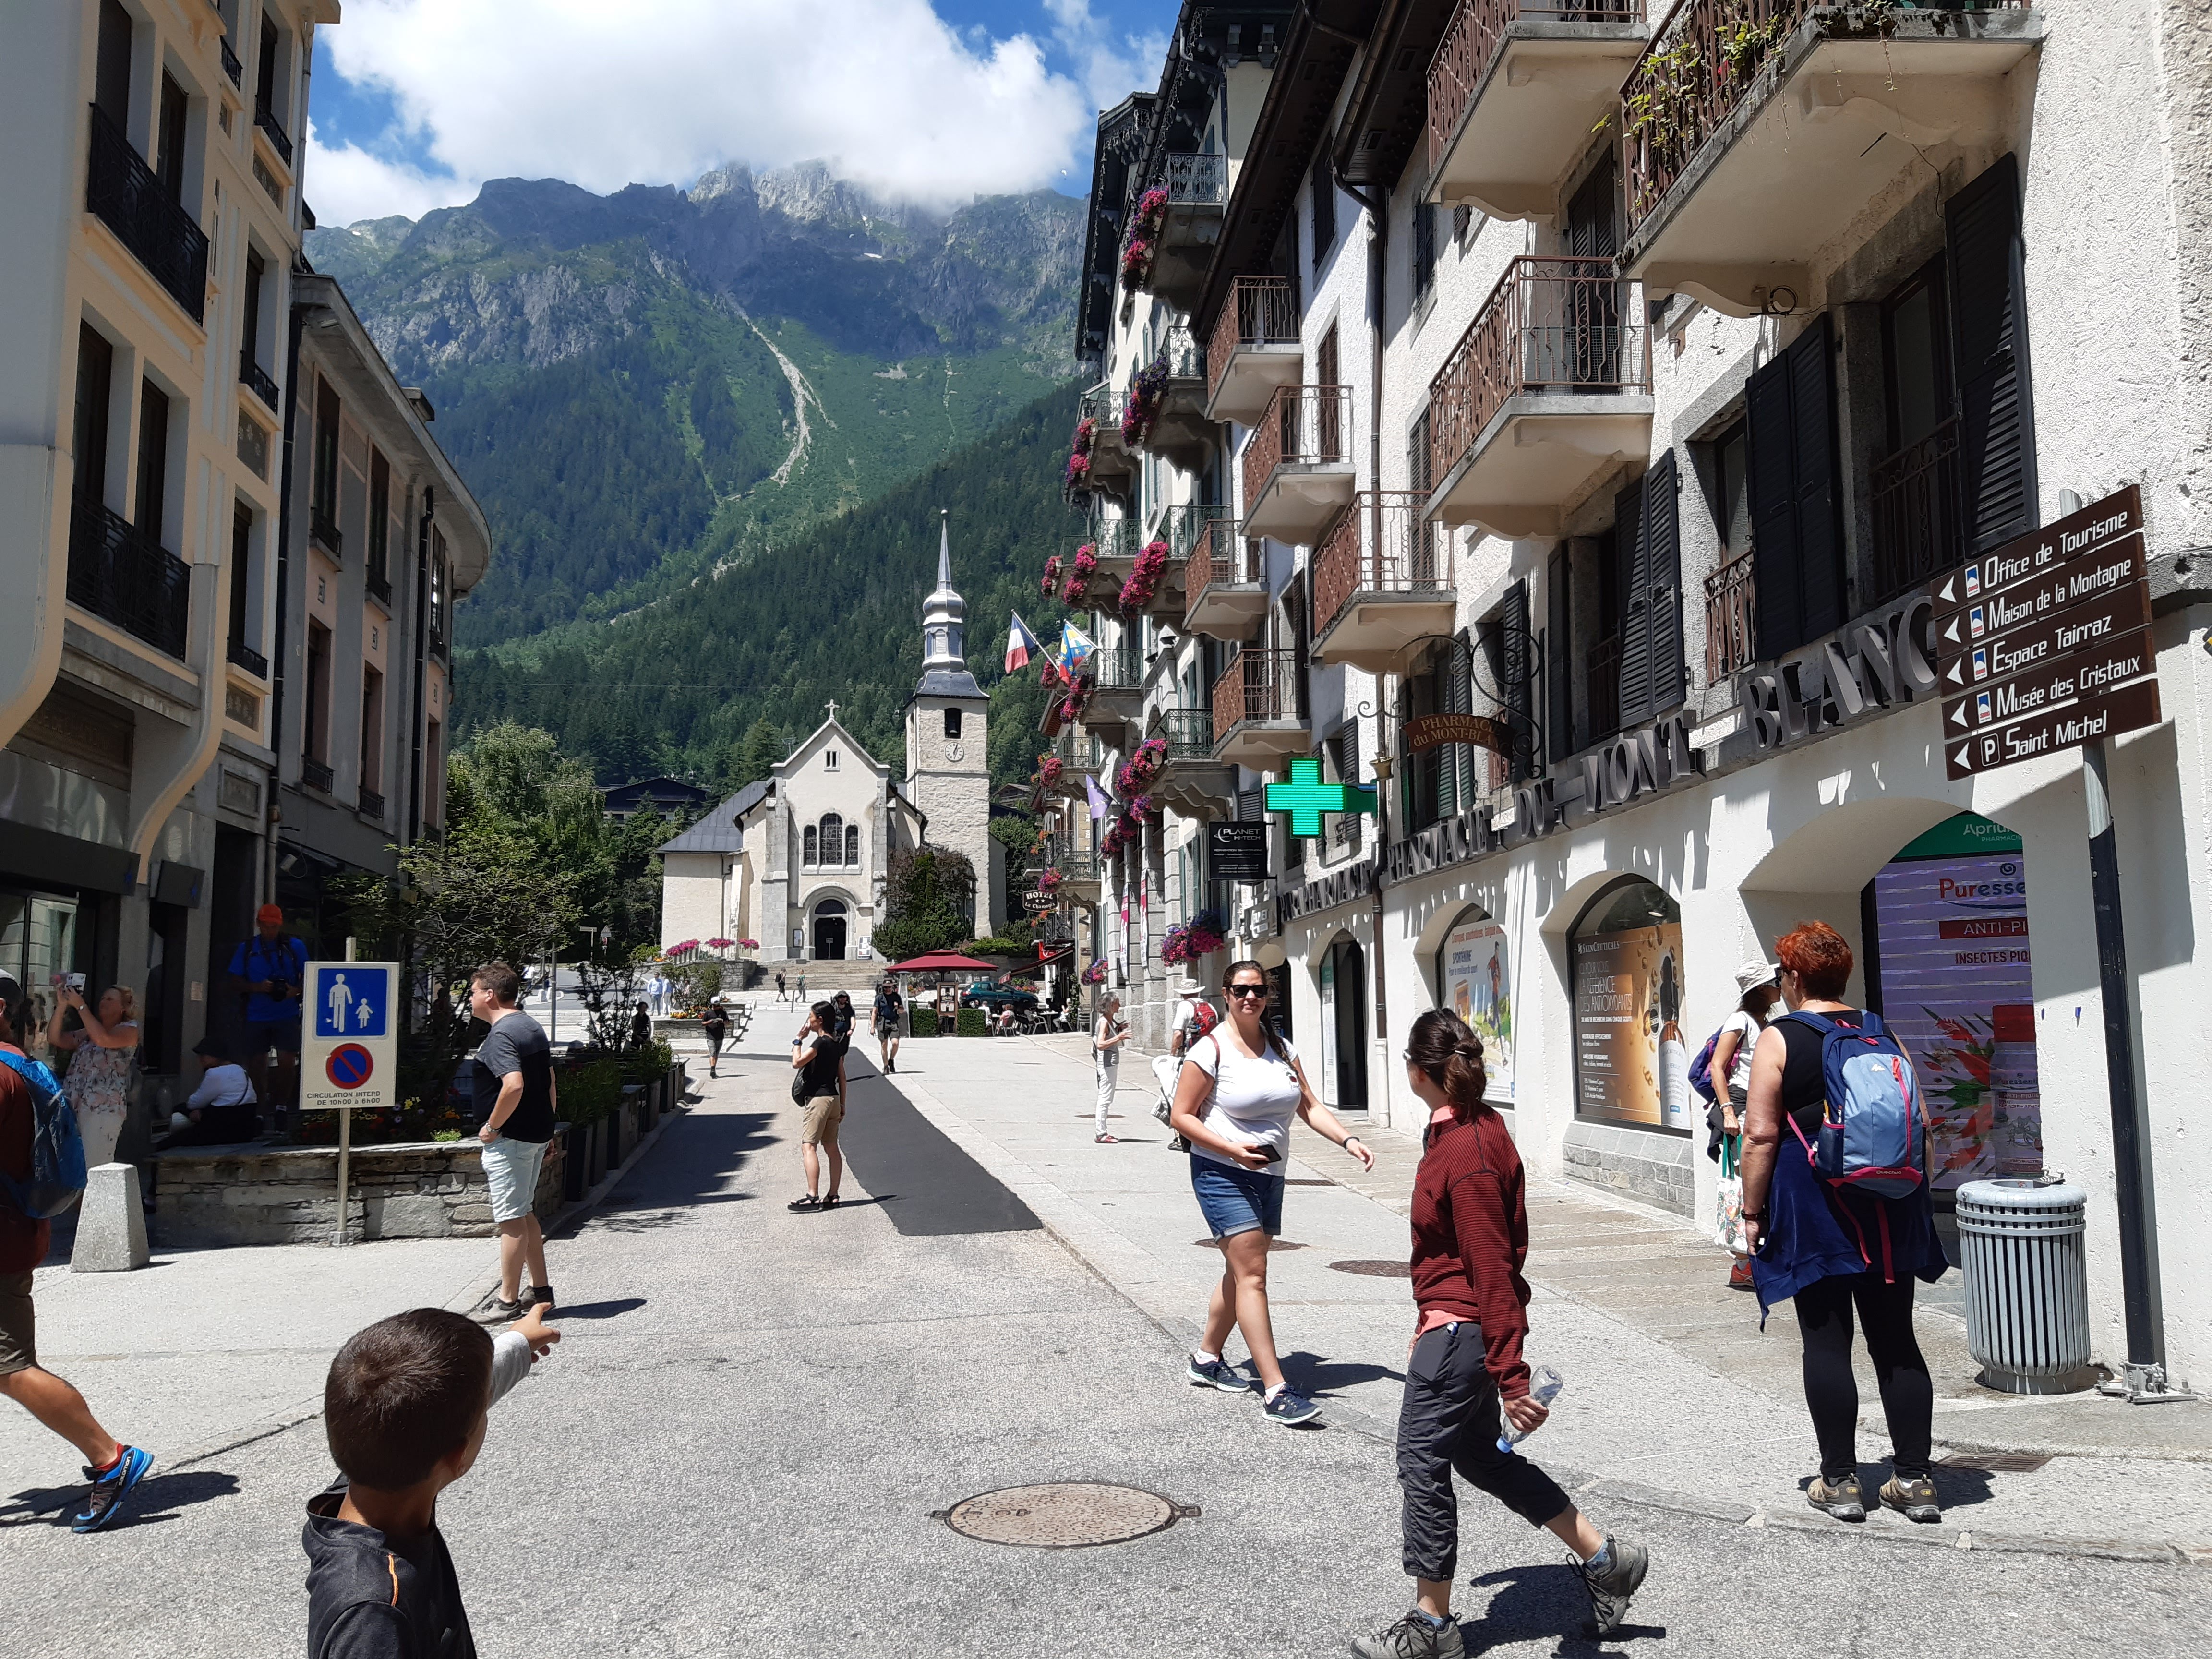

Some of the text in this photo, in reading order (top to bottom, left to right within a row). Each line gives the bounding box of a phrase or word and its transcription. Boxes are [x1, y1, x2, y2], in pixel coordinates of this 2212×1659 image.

[1984, 511, 2128, 589] Office de Tourisme
[1989, 559, 2131, 631] Maison de la Montagne
[1993, 615, 2112, 674] Espace Tairraz
[1996, 655, 2140, 717] Musée des Cristaux
[1387, 597, 1940, 883] PHARMACIE DU MONT BLANC
[1421, 715, 1502, 735] PHARMACIE
[1984, 710, 2107, 762] P Saint Michel
[1413, 734, 1429, 747] du
[1963, 821, 2011, 837] Apriu
[1026, 891, 1054, 900] HOTEL
[1963, 921, 2026, 935] ANTI-PI
[1955, 951, 2007, 964] INSECTES
[118, 1456, 132, 1486] salomon
